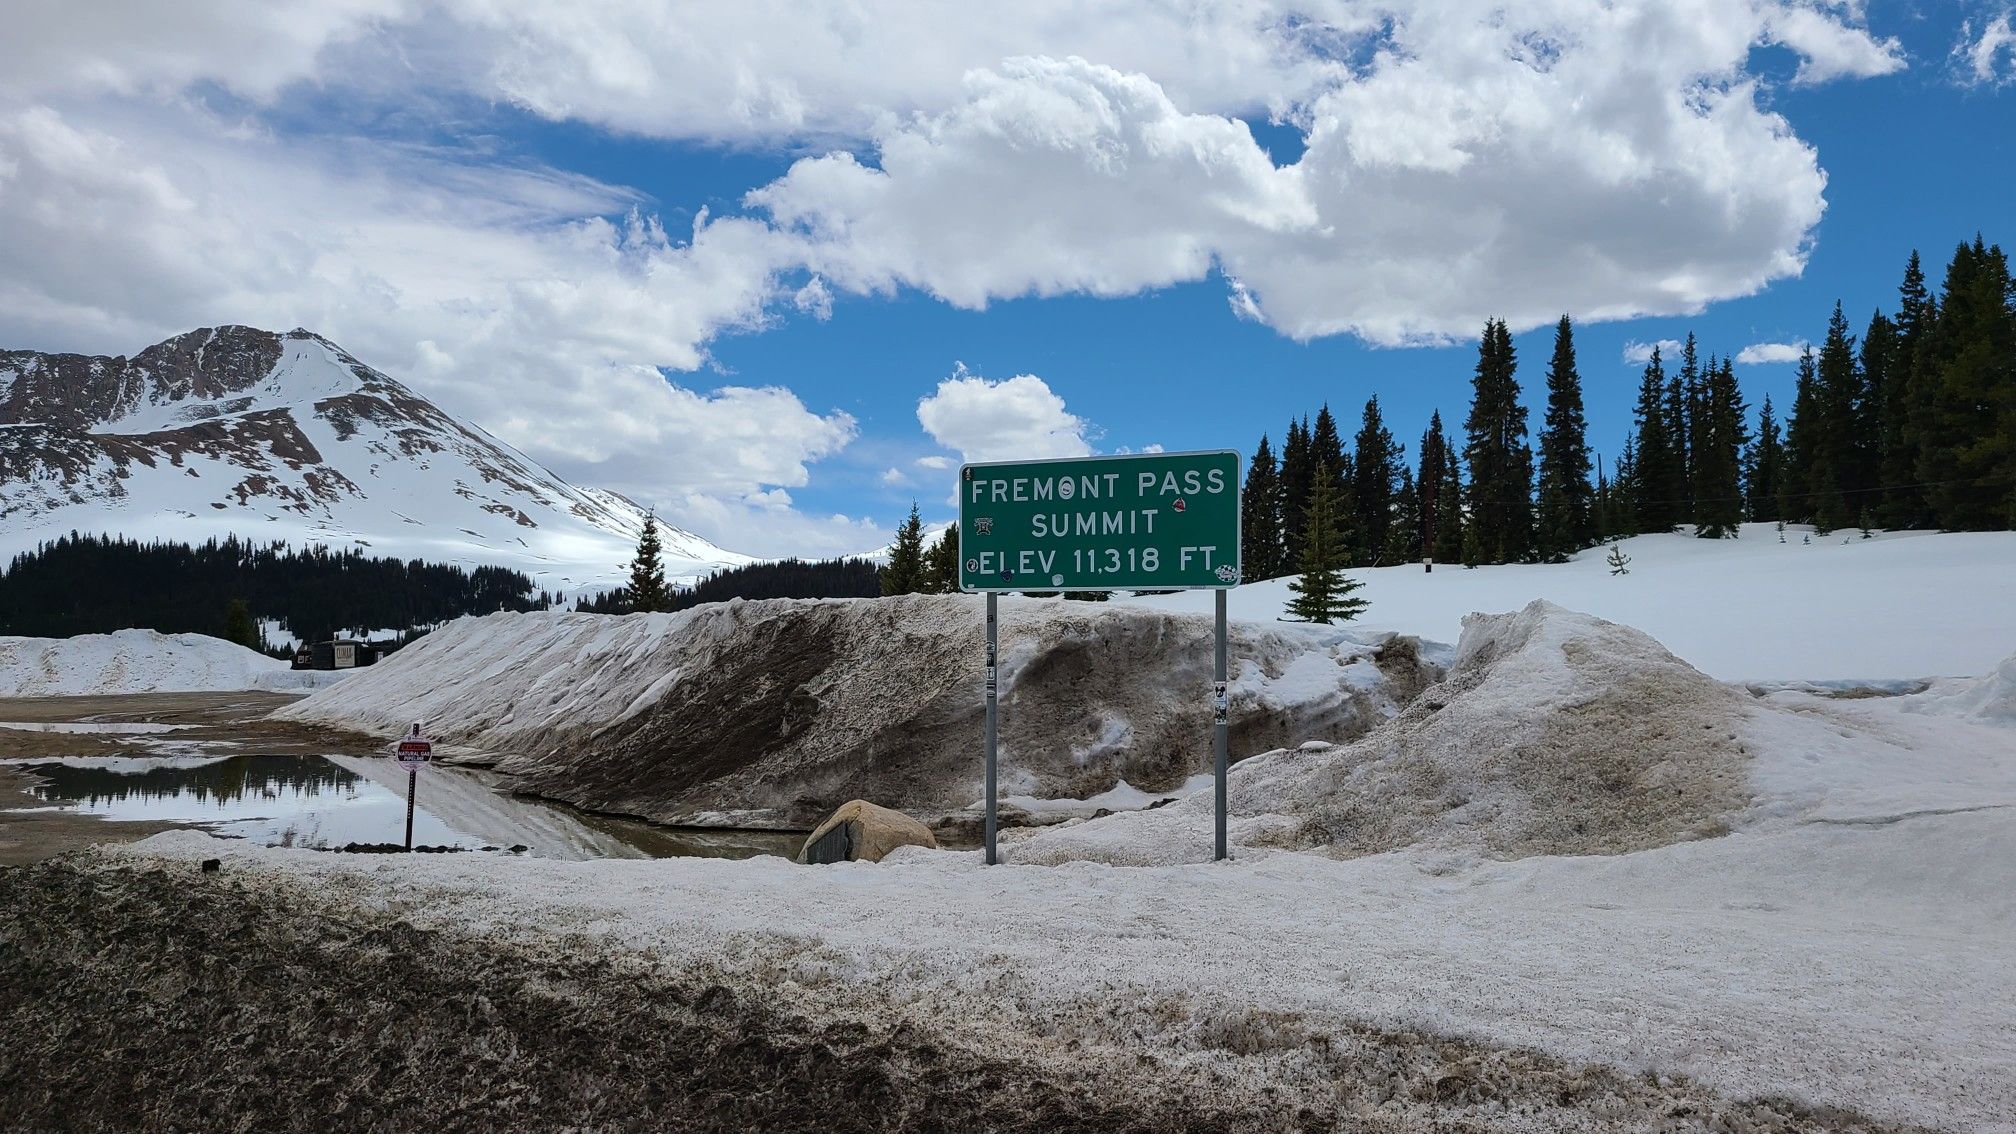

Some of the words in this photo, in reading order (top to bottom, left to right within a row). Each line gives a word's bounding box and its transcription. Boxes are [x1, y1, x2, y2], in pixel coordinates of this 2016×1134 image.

[972, 474, 1120, 504] FREMONT
[1138, 468, 1225, 497] PASS
[1031, 509, 1159, 538] SUMMIT
[979, 550, 1056, 575] ELEV
[1074, 547, 1160, 574] 11,318
[1180, 546, 1217, 571] FT
